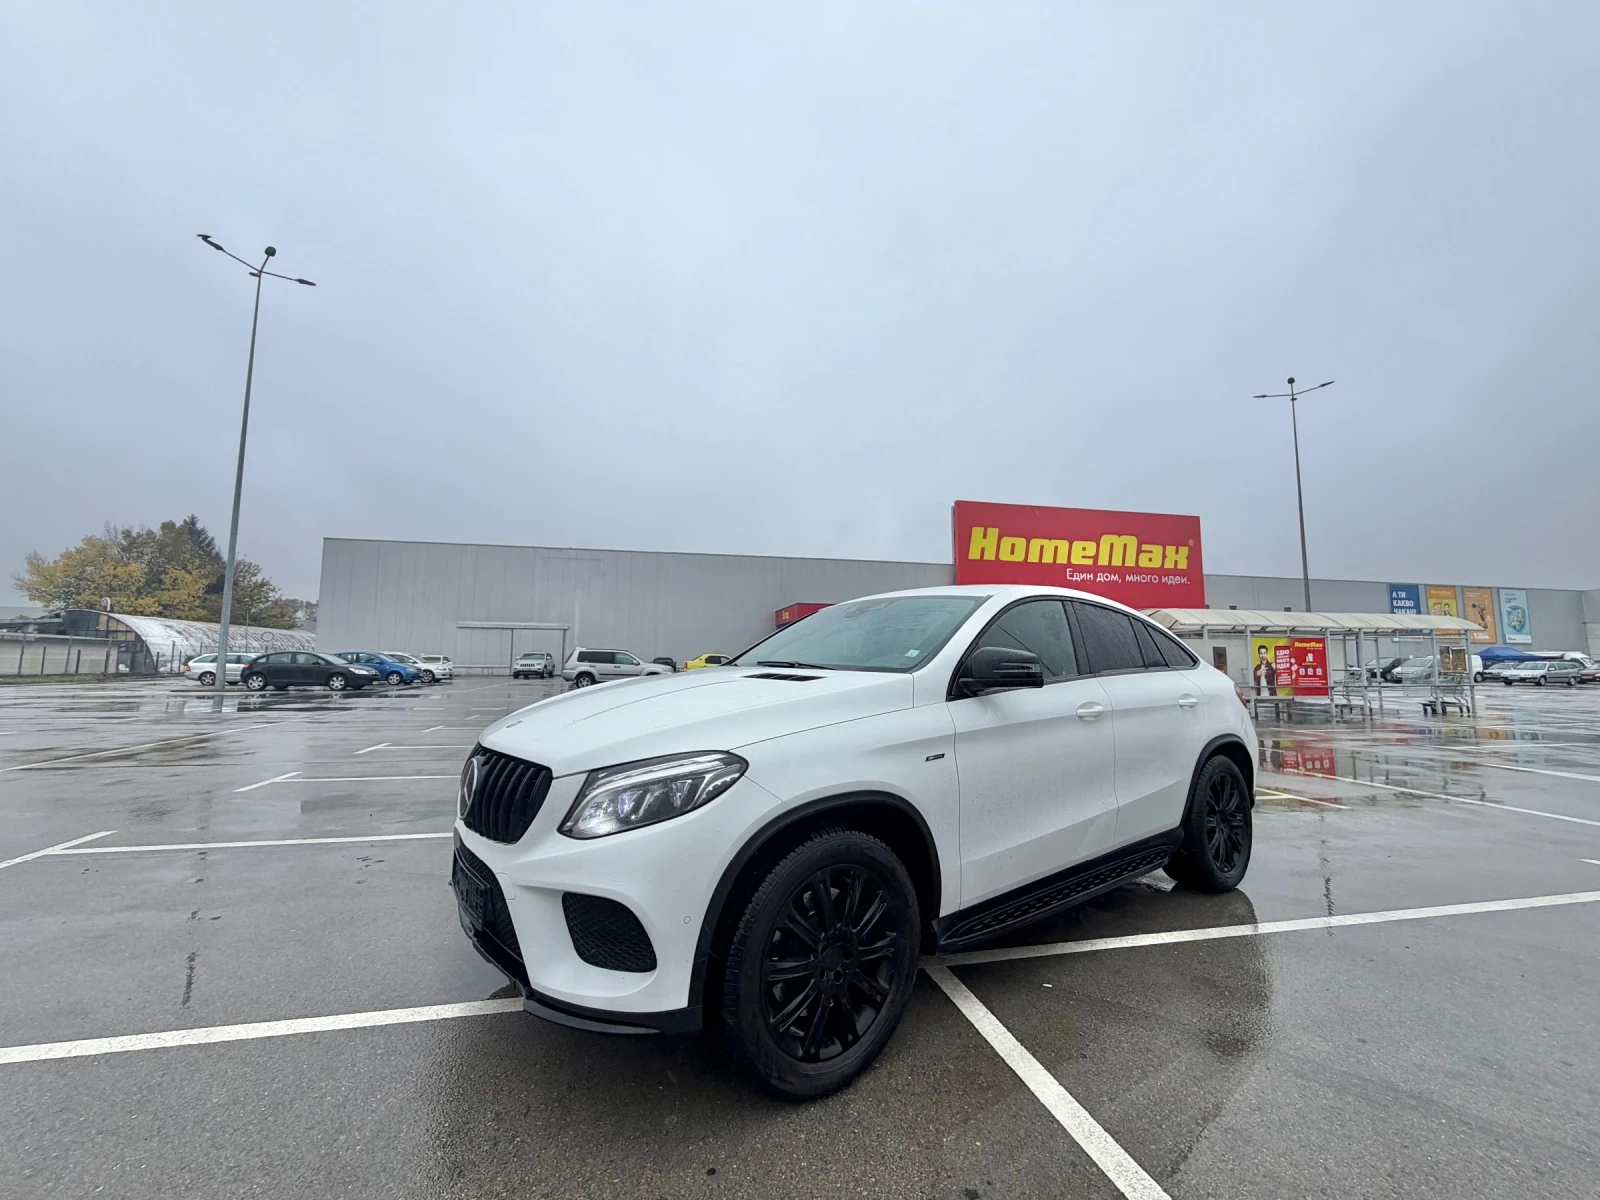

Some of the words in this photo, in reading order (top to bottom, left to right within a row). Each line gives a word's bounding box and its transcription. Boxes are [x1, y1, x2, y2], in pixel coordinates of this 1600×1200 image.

[968, 526, 1188, 569] HomeMax
[1066, 568, 1093, 582] Един
[1096, 572, 1121, 583] дом,
[1125, 574, 1159, 583] много
[1161, 575, 1190, 585] идеи.
